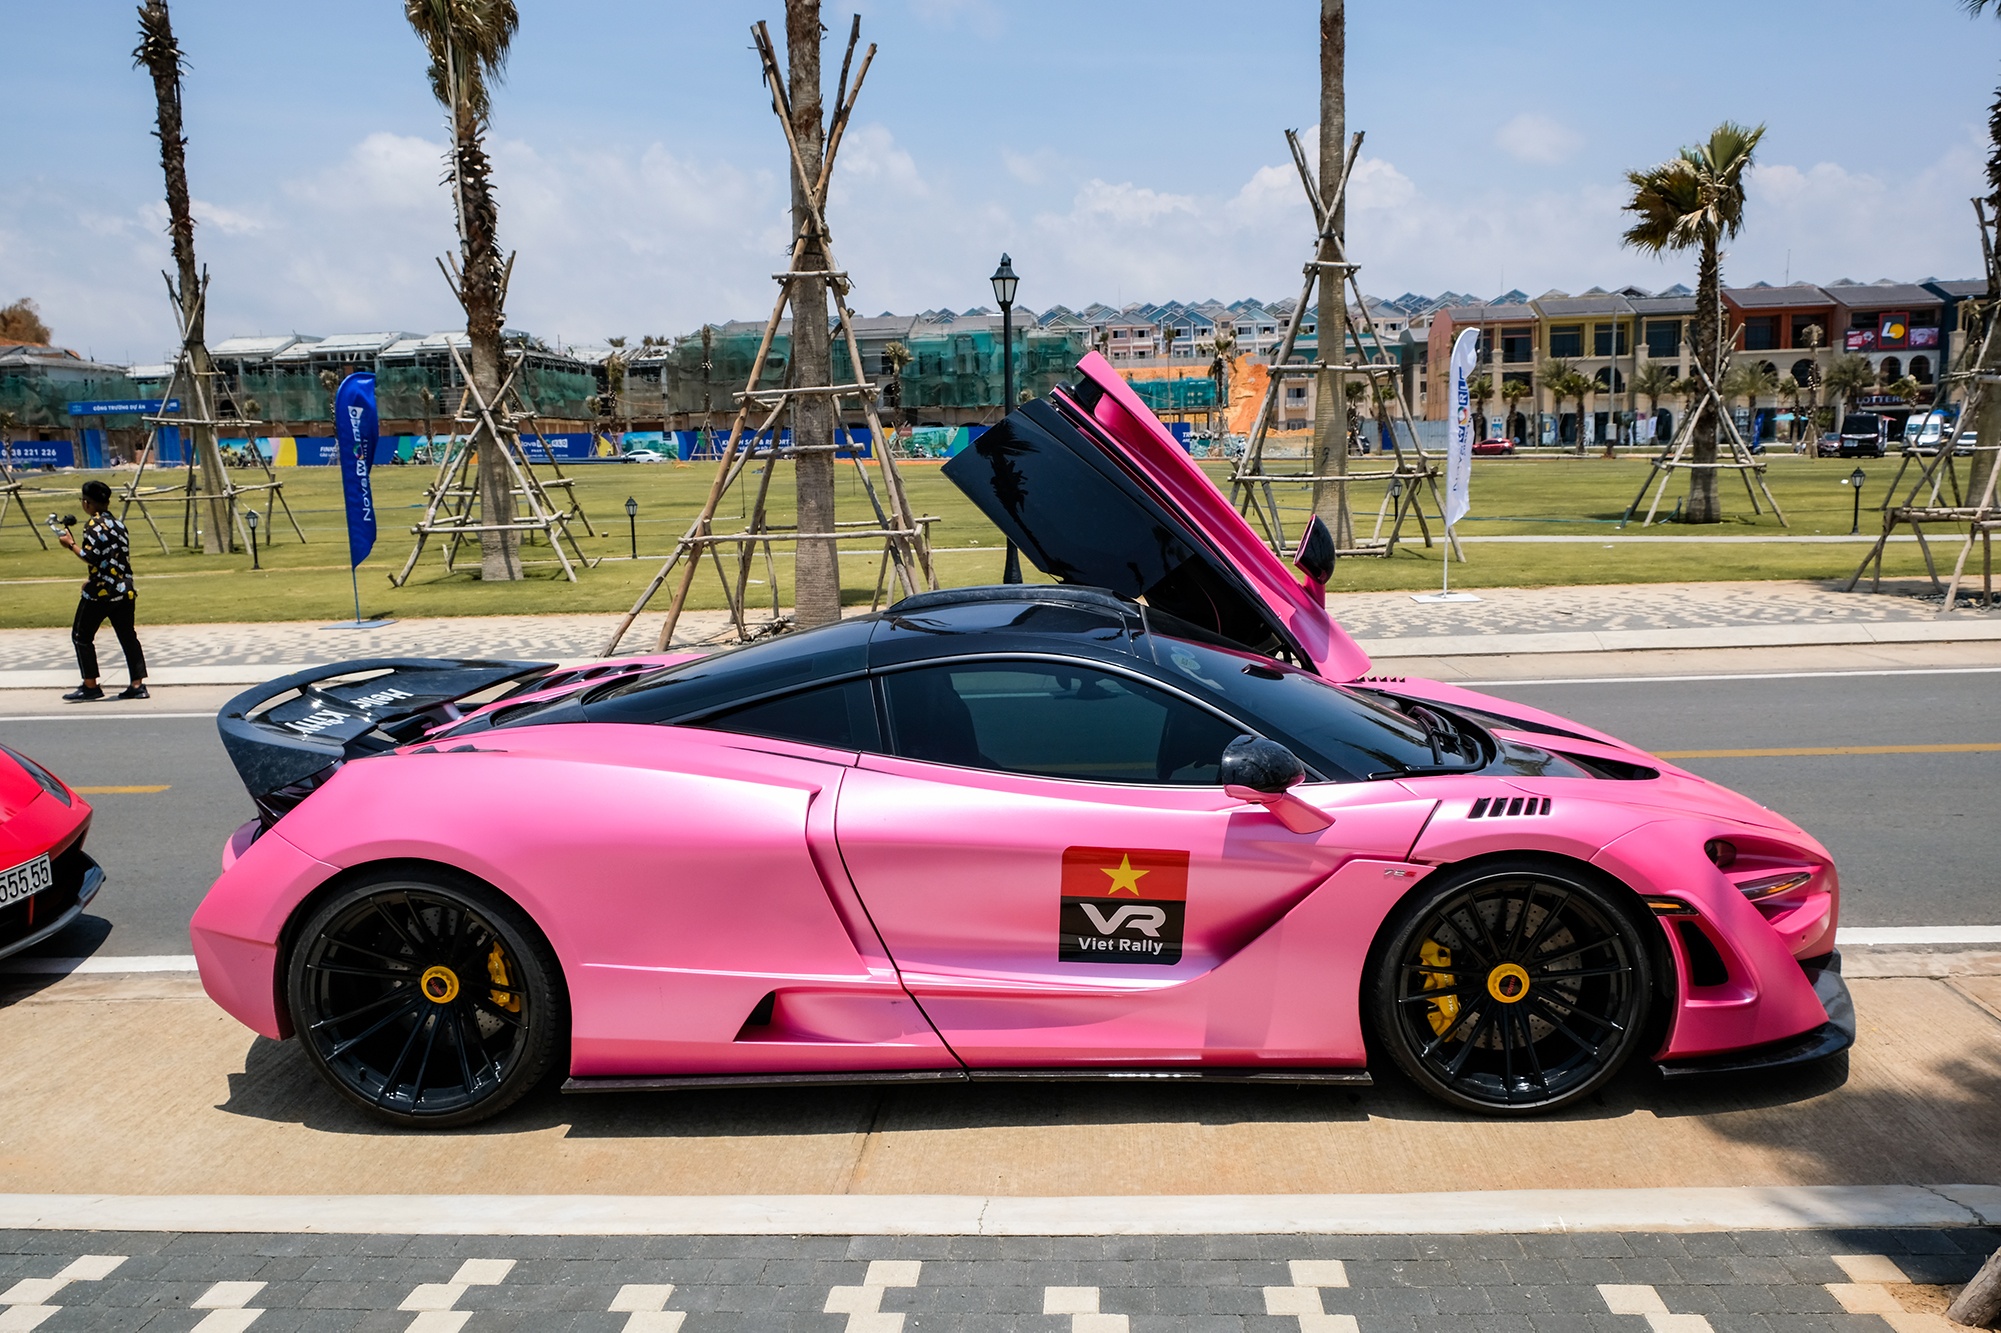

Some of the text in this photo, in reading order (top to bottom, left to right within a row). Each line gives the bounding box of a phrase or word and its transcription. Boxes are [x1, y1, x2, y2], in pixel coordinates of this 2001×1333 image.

[24, 448, 38, 456] 221
[41, 448, 57, 456] 226
[1079, 903, 1167, 938] VR
[1078, 937, 1164, 955] Viet Rally
